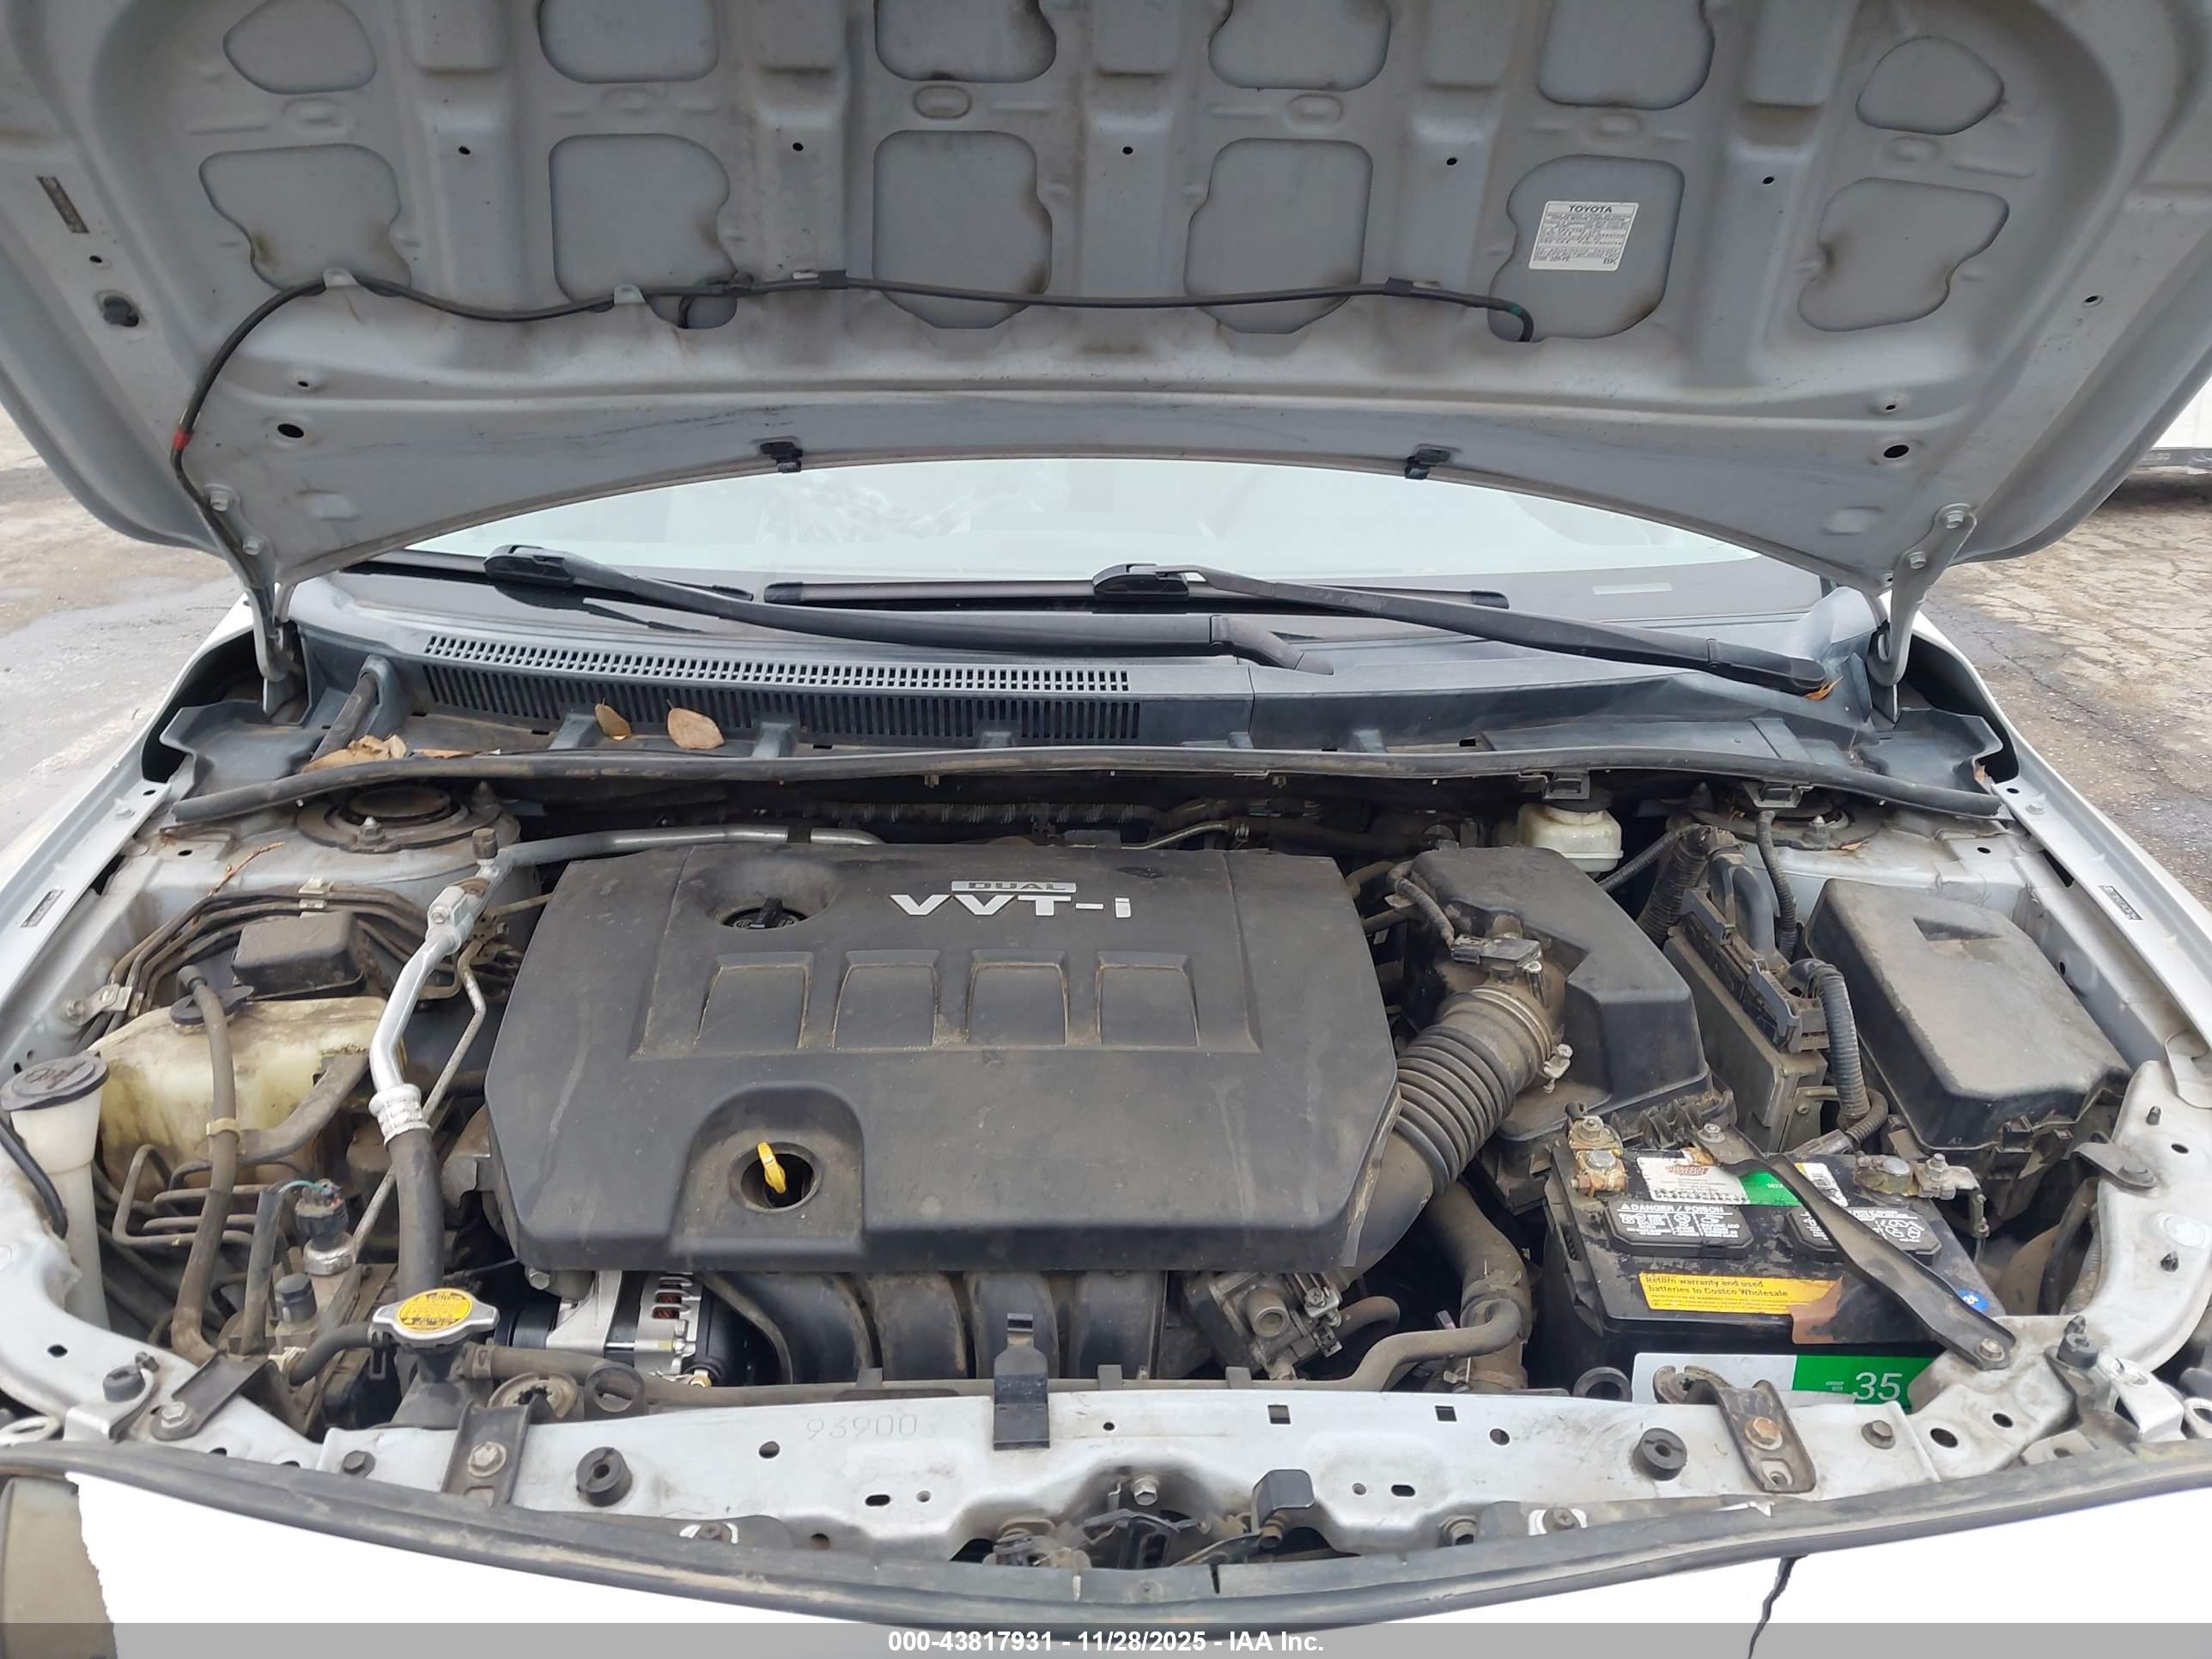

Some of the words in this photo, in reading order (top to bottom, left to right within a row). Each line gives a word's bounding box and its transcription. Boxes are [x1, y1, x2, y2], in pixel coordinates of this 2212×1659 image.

[1568, 205, 1613, 214] TOYOTA
[968, 881, 1066, 890] DUAL
[1631, 1204, 1674, 1212] DANGER
[1645, 1276, 1676, 1285] Return
[1680, 1278, 1718, 1287] warranty
[1722, 1279, 1740, 1287] and
[1649, 1285, 1689, 1293] batteries
[1692, 1285, 1702, 1294] to
[1705, 1286, 1737, 1296] Costco
[1740, 1288, 1788, 1297] Wholesale
[1853, 1371, 1903, 1401] 35
[805, 1413, 918, 1441] 93900
